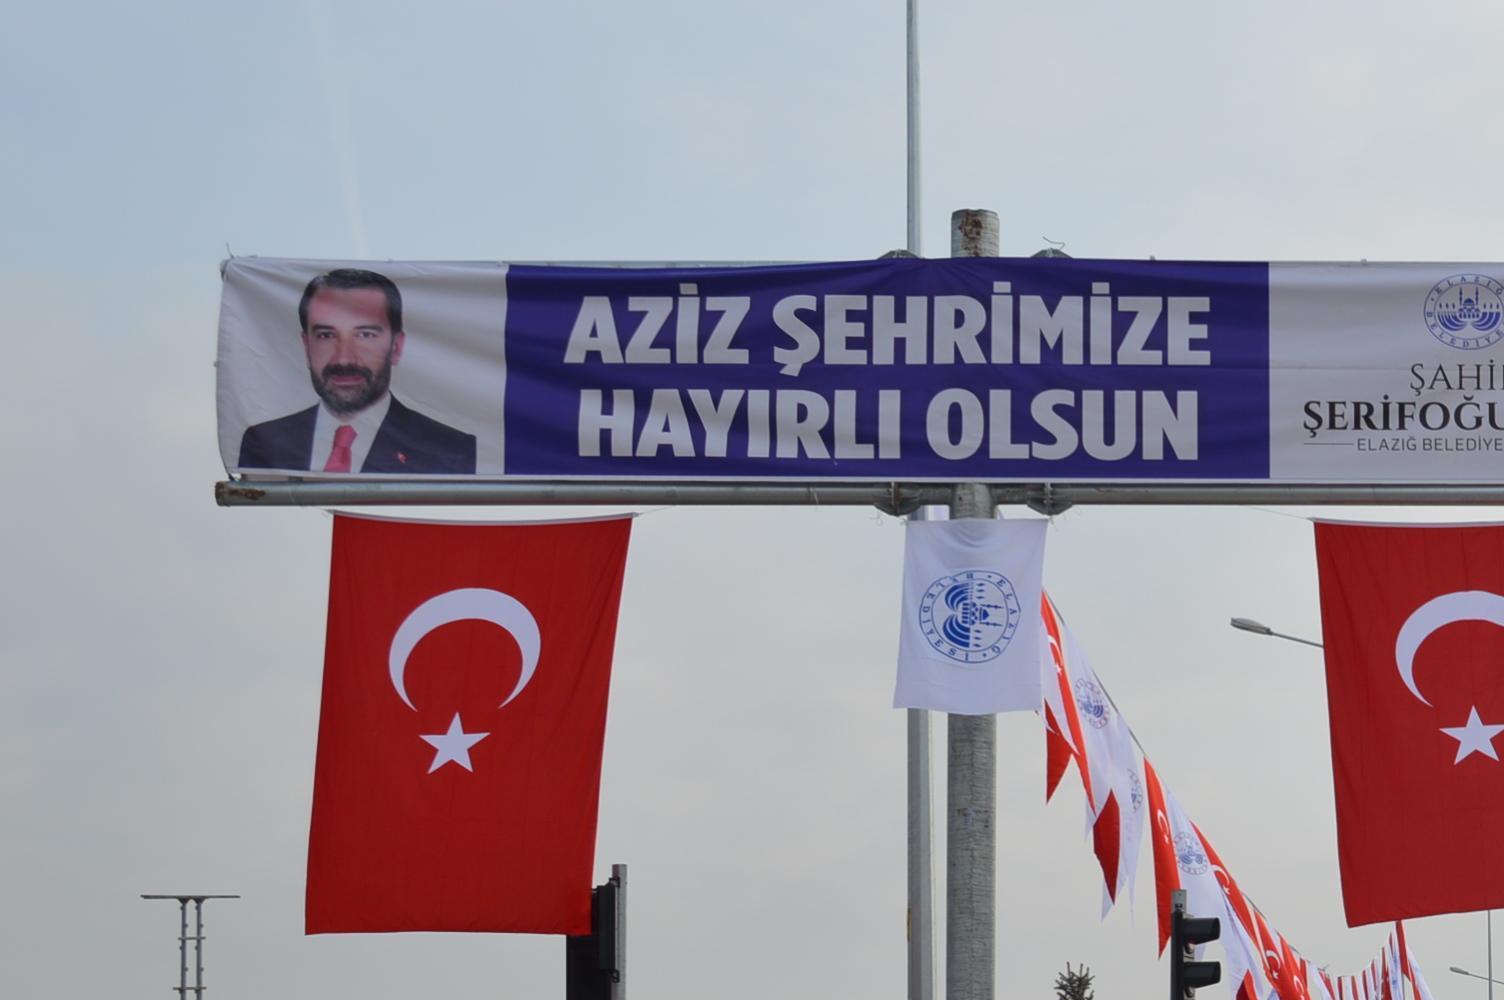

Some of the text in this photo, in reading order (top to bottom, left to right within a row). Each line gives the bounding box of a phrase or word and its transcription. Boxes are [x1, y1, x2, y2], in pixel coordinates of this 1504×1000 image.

[563, 281, 1211, 376] AZİZ ŞEHRİMİZE
[577, 388, 1198, 461] HAYIRLI OLSUN
[1357, 436, 1418, 451] ELAZIĞ
[1422, 436, 1503, 451] BELEDİYE
